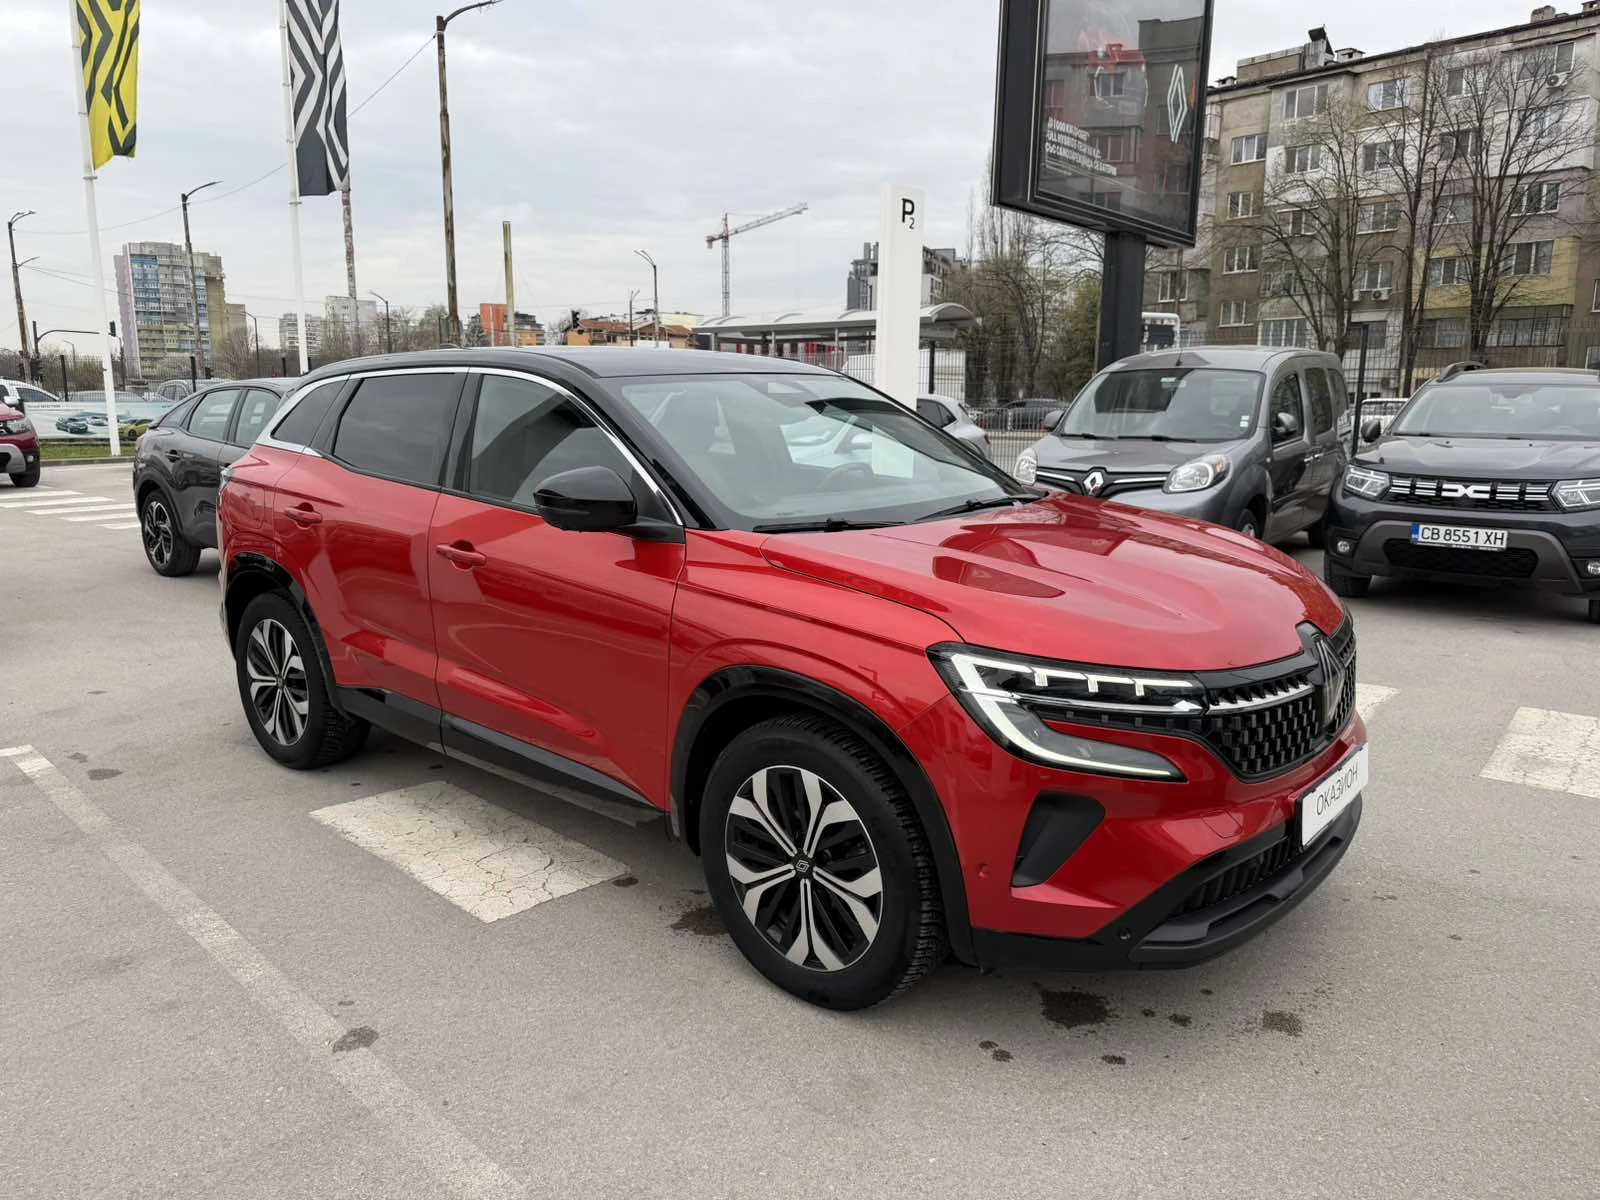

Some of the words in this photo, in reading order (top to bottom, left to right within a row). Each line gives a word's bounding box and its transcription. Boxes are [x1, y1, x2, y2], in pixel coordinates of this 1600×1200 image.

[1421, 527, 1440, 541] CB
[1443, 528, 1479, 544] 8551
[1483, 531, 1505, 546] XH
[1316, 761, 1359, 816] ОКАЗИОН
